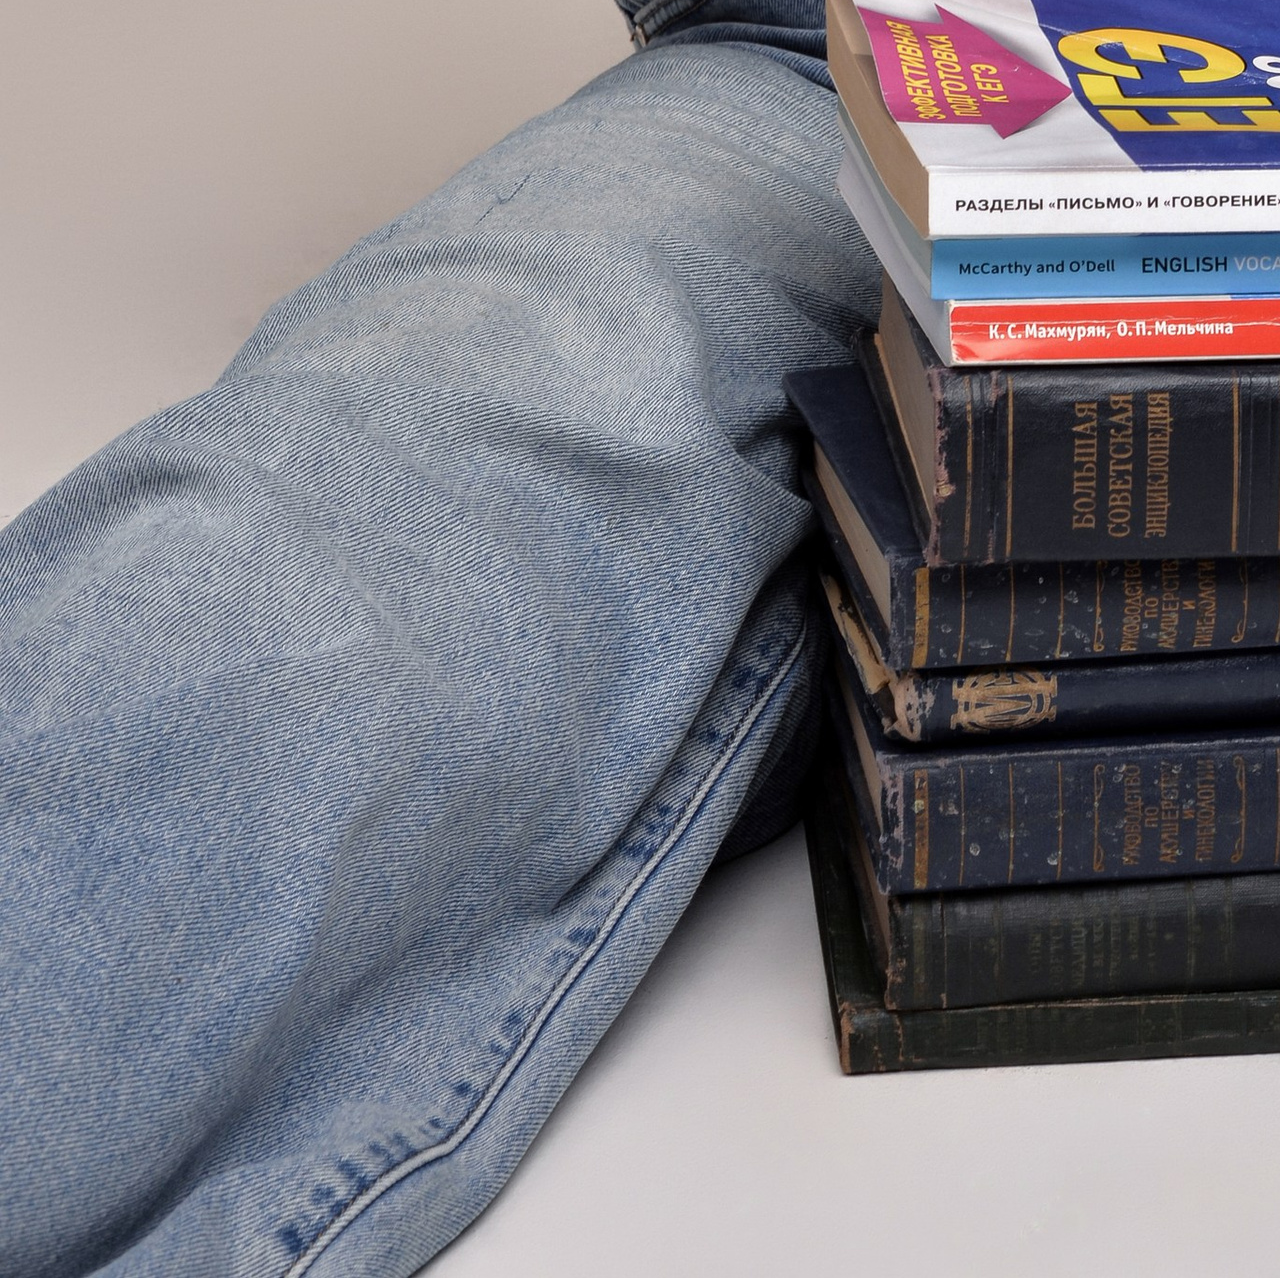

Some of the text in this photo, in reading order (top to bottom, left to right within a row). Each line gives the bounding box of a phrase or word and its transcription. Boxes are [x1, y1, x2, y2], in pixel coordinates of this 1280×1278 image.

[886, 20, 946, 120] ЭФФЕКТИВНАЯ
[925, 35, 982, 117] ПОДГОТОВКА
[970, 63, 1009, 103] К ЕГЭ
[955, 198, 1043, 213] РАЗДЕЛЫ
[1048, 196, 1142, 211] «ПИСЬМО»
[1147, 196, 1159, 209] И
[959, 261, 1030, 277] McCarthy
[1036, 260, 1064, 274] and
[1142, 256, 1228, 274] ENGLISH
[1025, 322, 1111, 341] Махмурян,
[1154, 320, 1234, 337] Мельчина
[1072, 401, 1098, 530] БОЛЬШАЯ
[1107, 392, 1134, 538] СОВЕТСКАЯ
[1143, 391, 1174, 539] ЭНЦИКЛОПЕДИЯ
[1144, 596, 1159, 618] ПО
[1182, 599, 1196, 611] И
[1122, 763, 1143, 866] РУКОВОДСТВО
[1144, 806, 1159, 828] ПО
[1182, 808, 1195, 820] И
